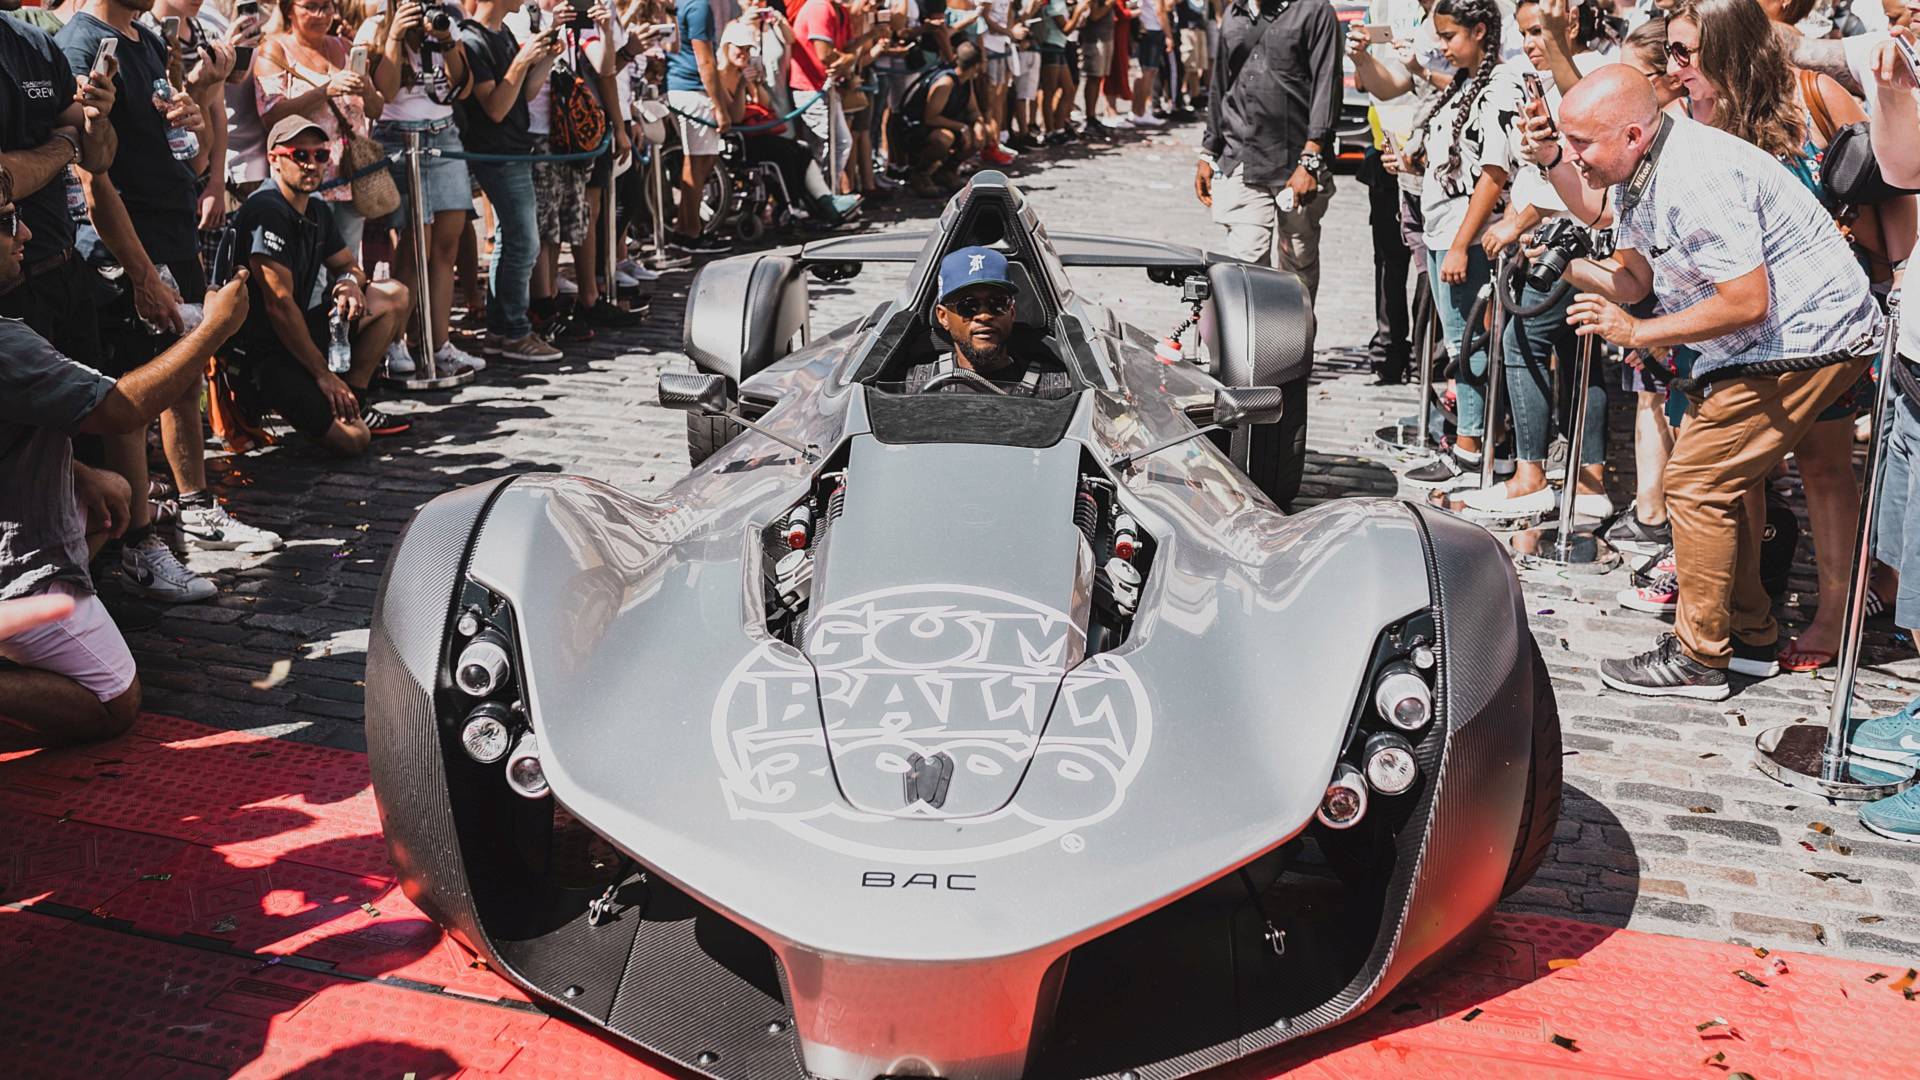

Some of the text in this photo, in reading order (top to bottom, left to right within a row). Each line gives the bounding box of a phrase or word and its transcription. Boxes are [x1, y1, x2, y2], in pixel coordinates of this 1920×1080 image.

[27, 87, 55, 99] CREW
[1633, 162, 1653, 189] Nikon
[733, 668, 1130, 755] BALL
[861, 871, 977, 891] BAC
